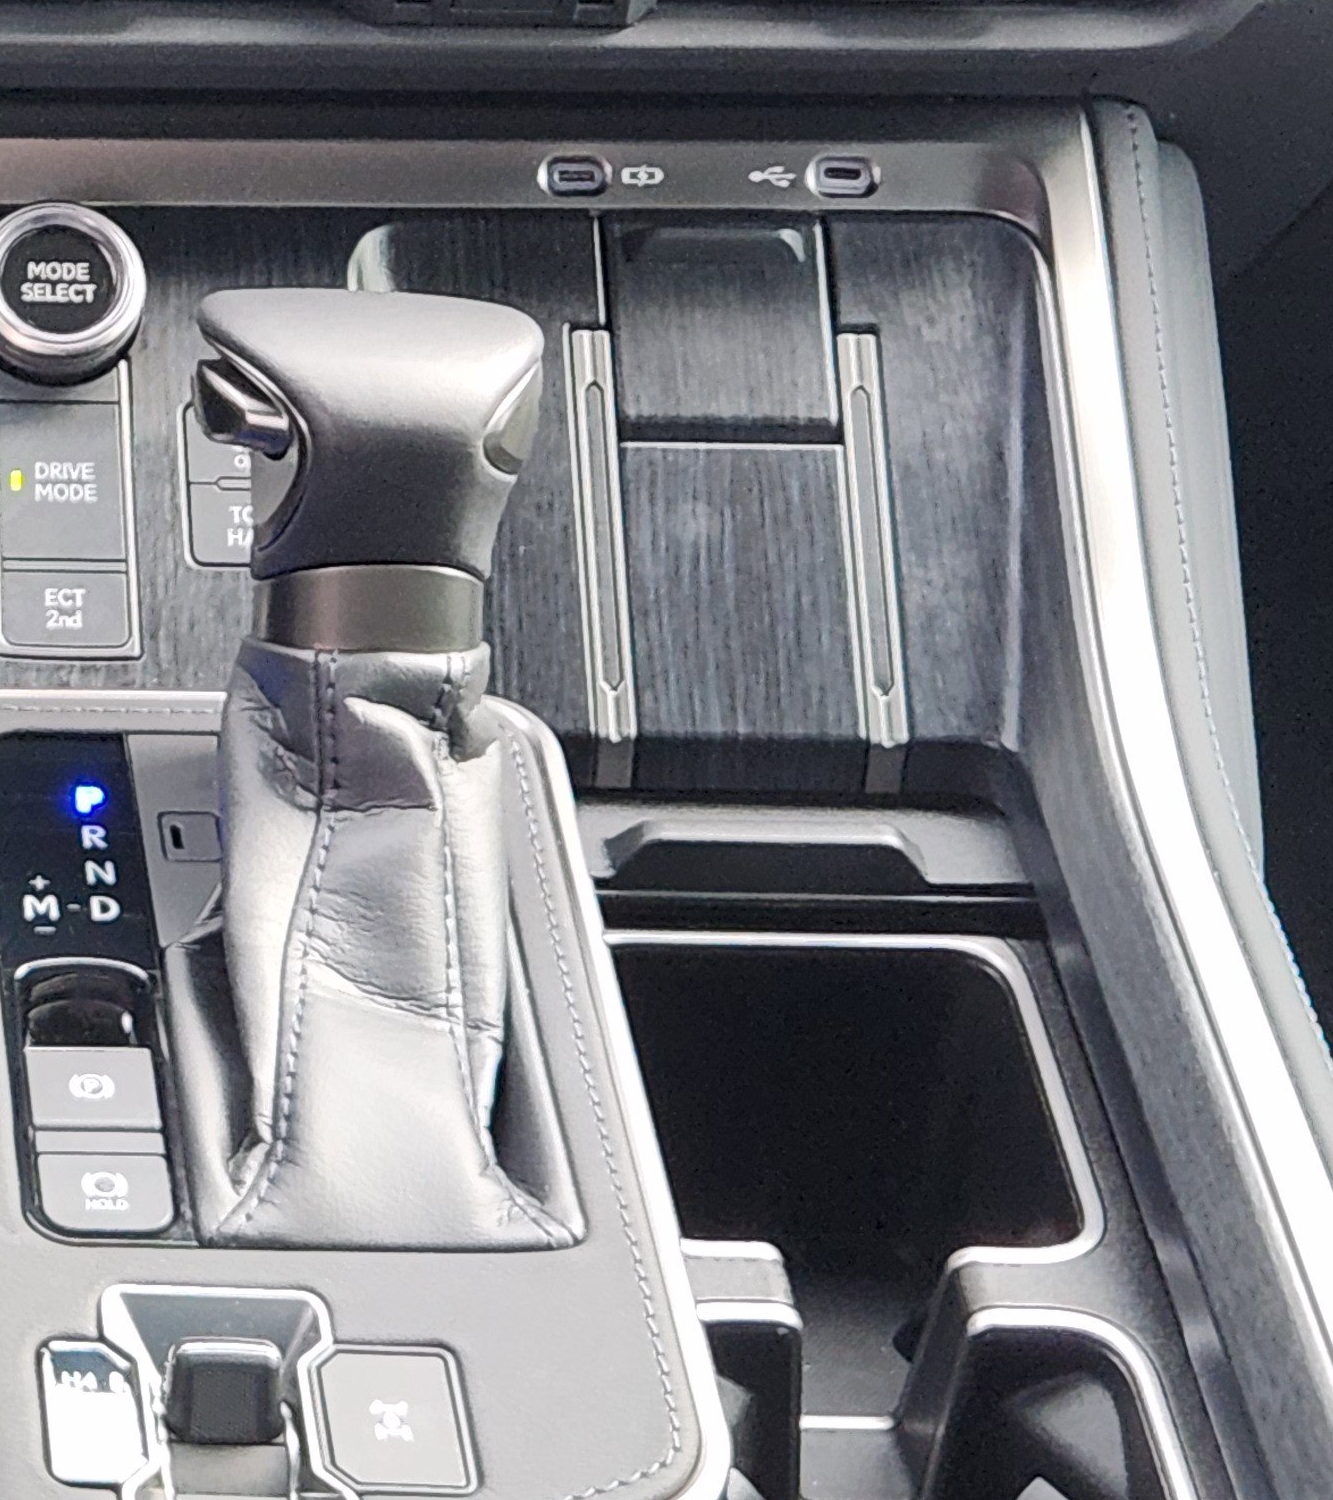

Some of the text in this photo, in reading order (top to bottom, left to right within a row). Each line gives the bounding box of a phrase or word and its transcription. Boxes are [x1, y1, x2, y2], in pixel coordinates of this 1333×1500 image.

[27, 261, 90, 282] MODE
[21, 283, 96, 303] SELECT
[34, 462, 95, 480] DRIVE
[34, 483, 97, 501] MODE
[44, 588, 85, 607] ECT
[45, 609, 83, 628] 2nd
[74, 786, 105, 813] P
[80, 824, 107, 850] R
[85, 859, 117, 886] N
